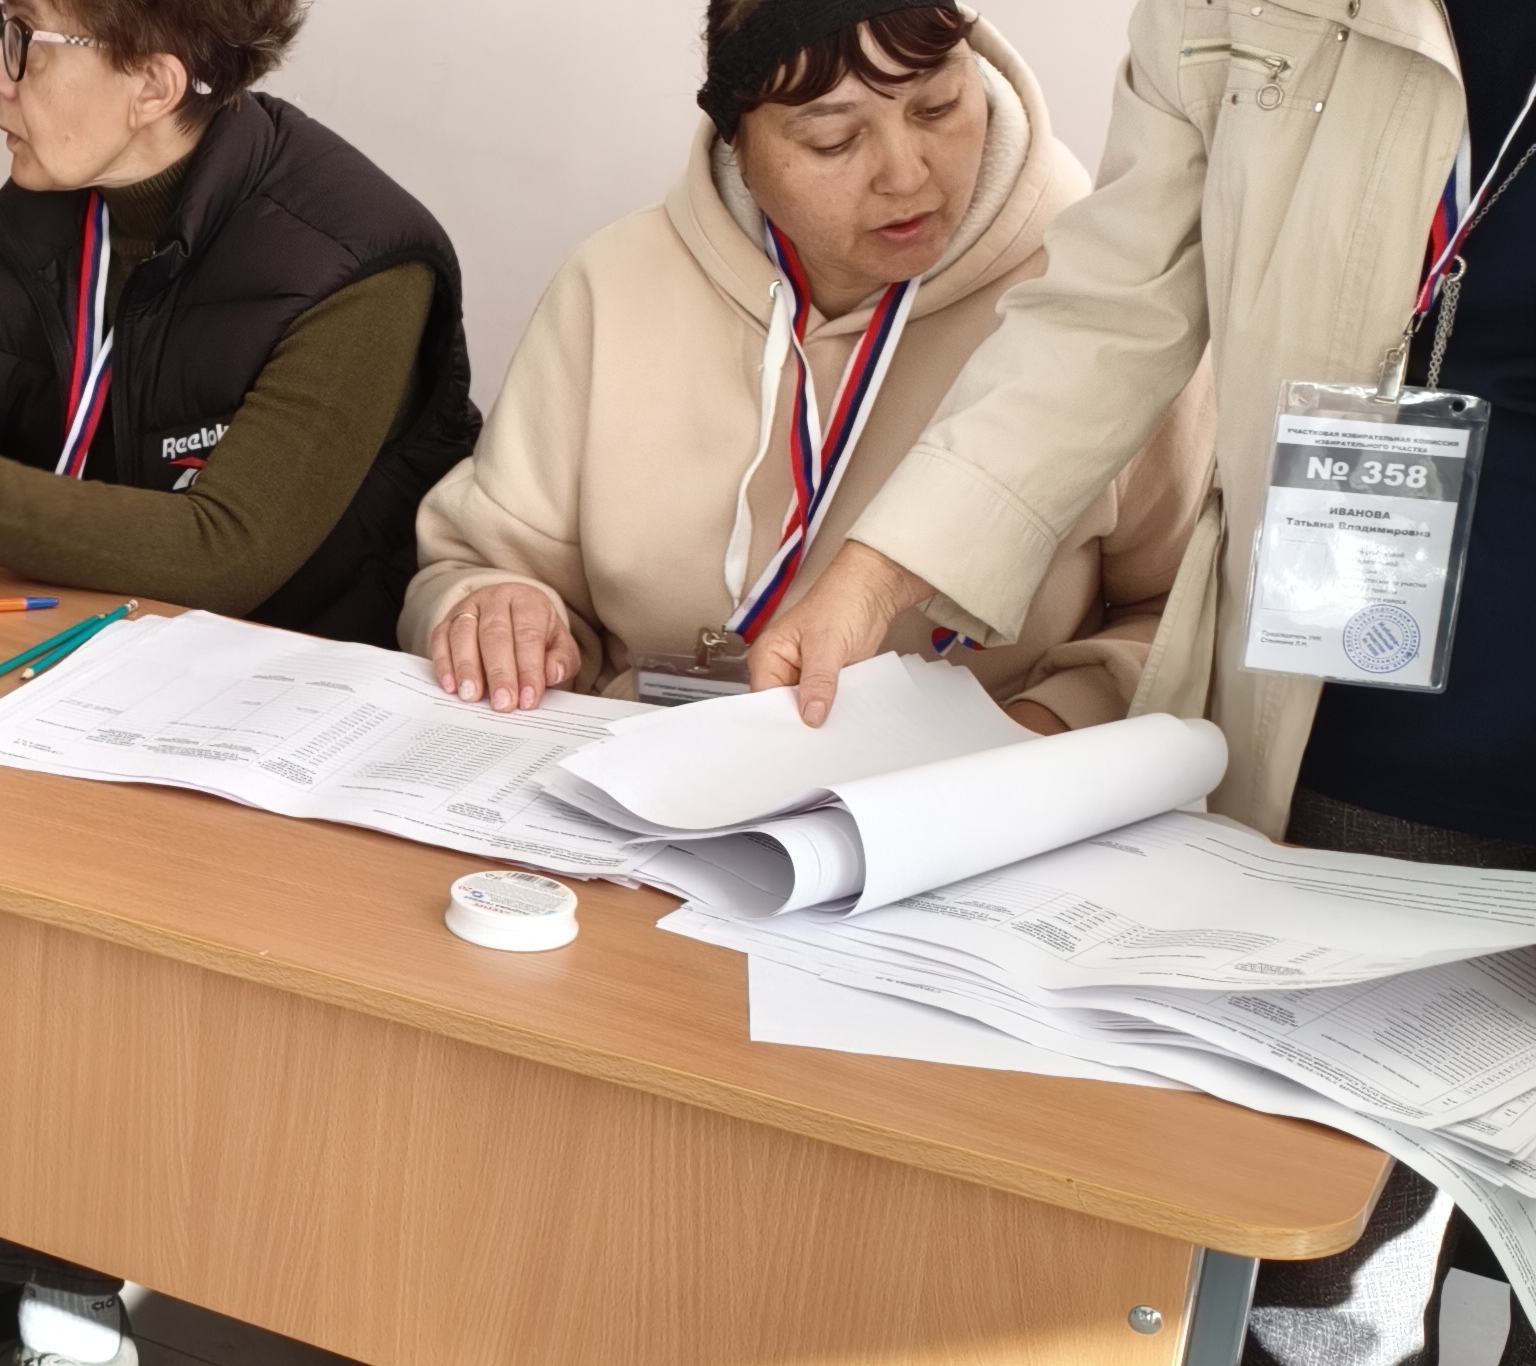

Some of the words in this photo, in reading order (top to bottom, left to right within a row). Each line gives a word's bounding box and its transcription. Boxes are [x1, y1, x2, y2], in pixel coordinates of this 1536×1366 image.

[1287, 428, 1339, 437] УЧАСТКОВАЯ
[1341, 433, 1411, 443] ИЗБИРАТЕЛЬНАЯ
[1413, 438, 1460, 447] КОМИССИЯ
[1314, 439, 1389, 450] ИЗБИРАТЕЛЬНОГО
[1391, 445, 1428, 453] УЧАСТКА
[1306, 456, 1350, 481] №
[1361, 460, 1428, 488] 358
[1329, 507, 1391, 520] ИВАНОВА
[1286, 517, 1334, 529] Татьяна
[1338, 522, 1431, 538] Владимировна
